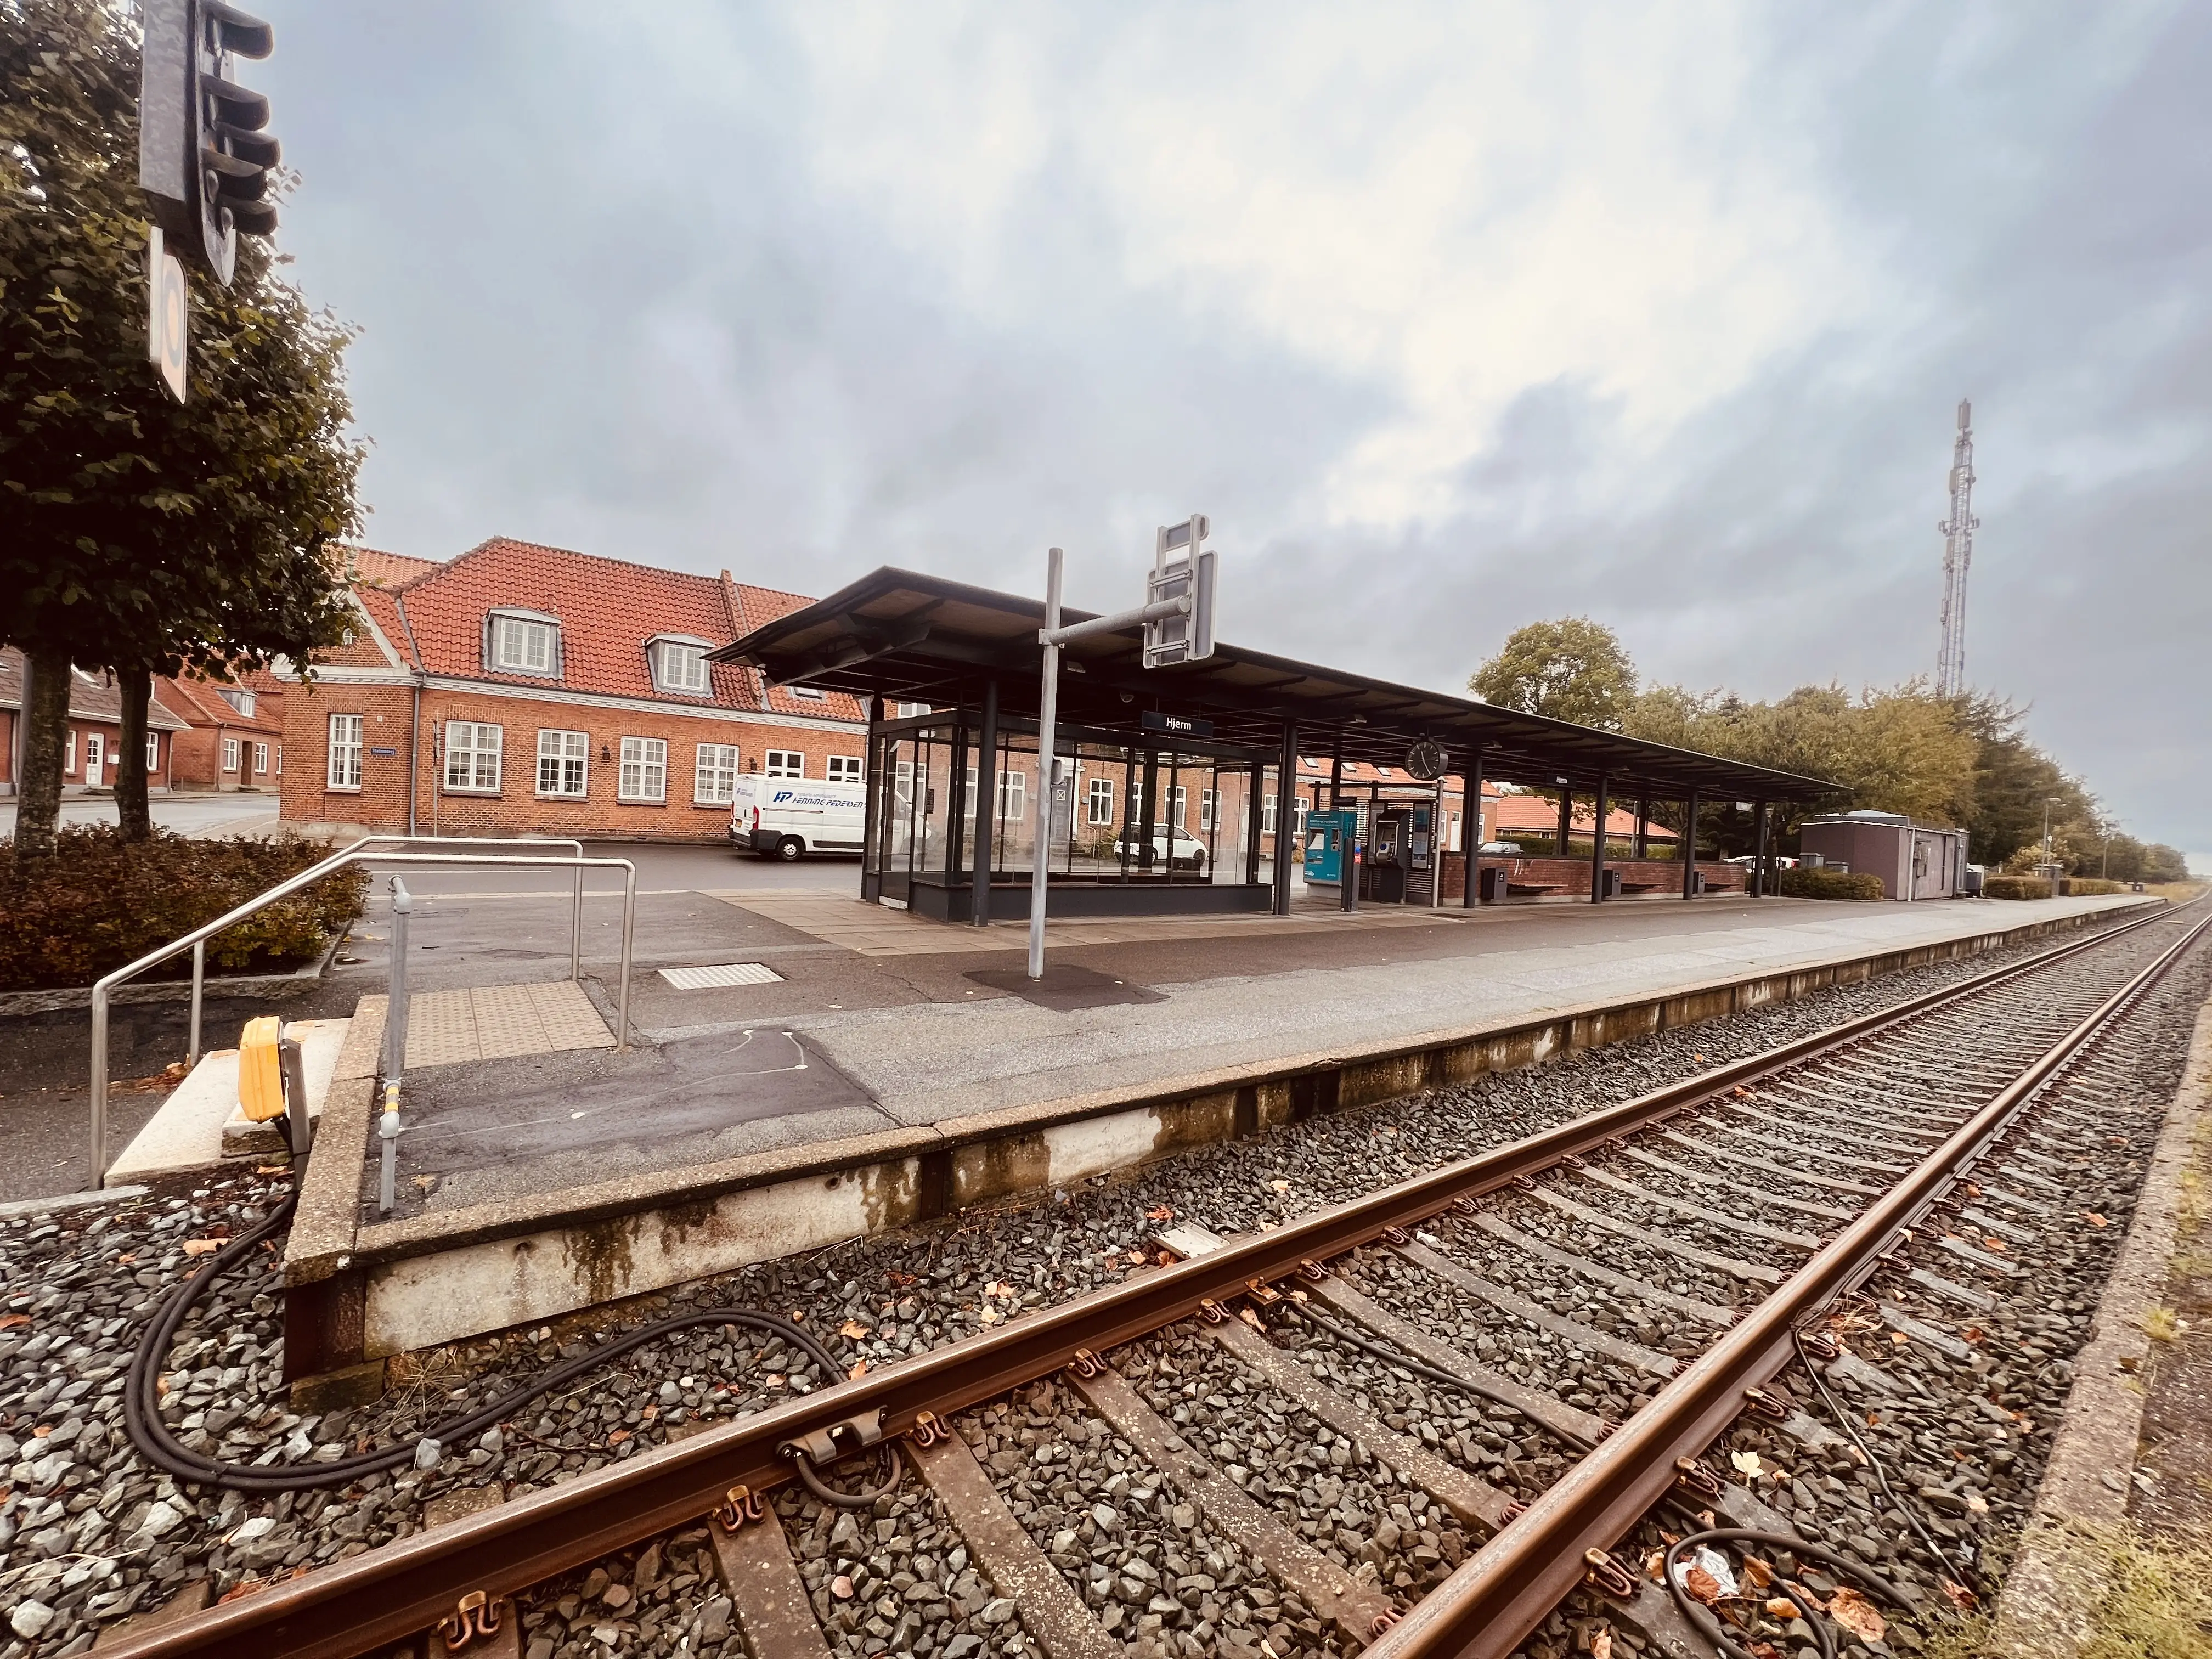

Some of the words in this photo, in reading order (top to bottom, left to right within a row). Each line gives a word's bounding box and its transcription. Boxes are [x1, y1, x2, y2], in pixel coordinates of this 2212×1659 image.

[1166, 717, 1192, 730] Hjerm
[792, 797, 826, 805] HENNING
[826, 799, 863, 808] PEDERSEN
